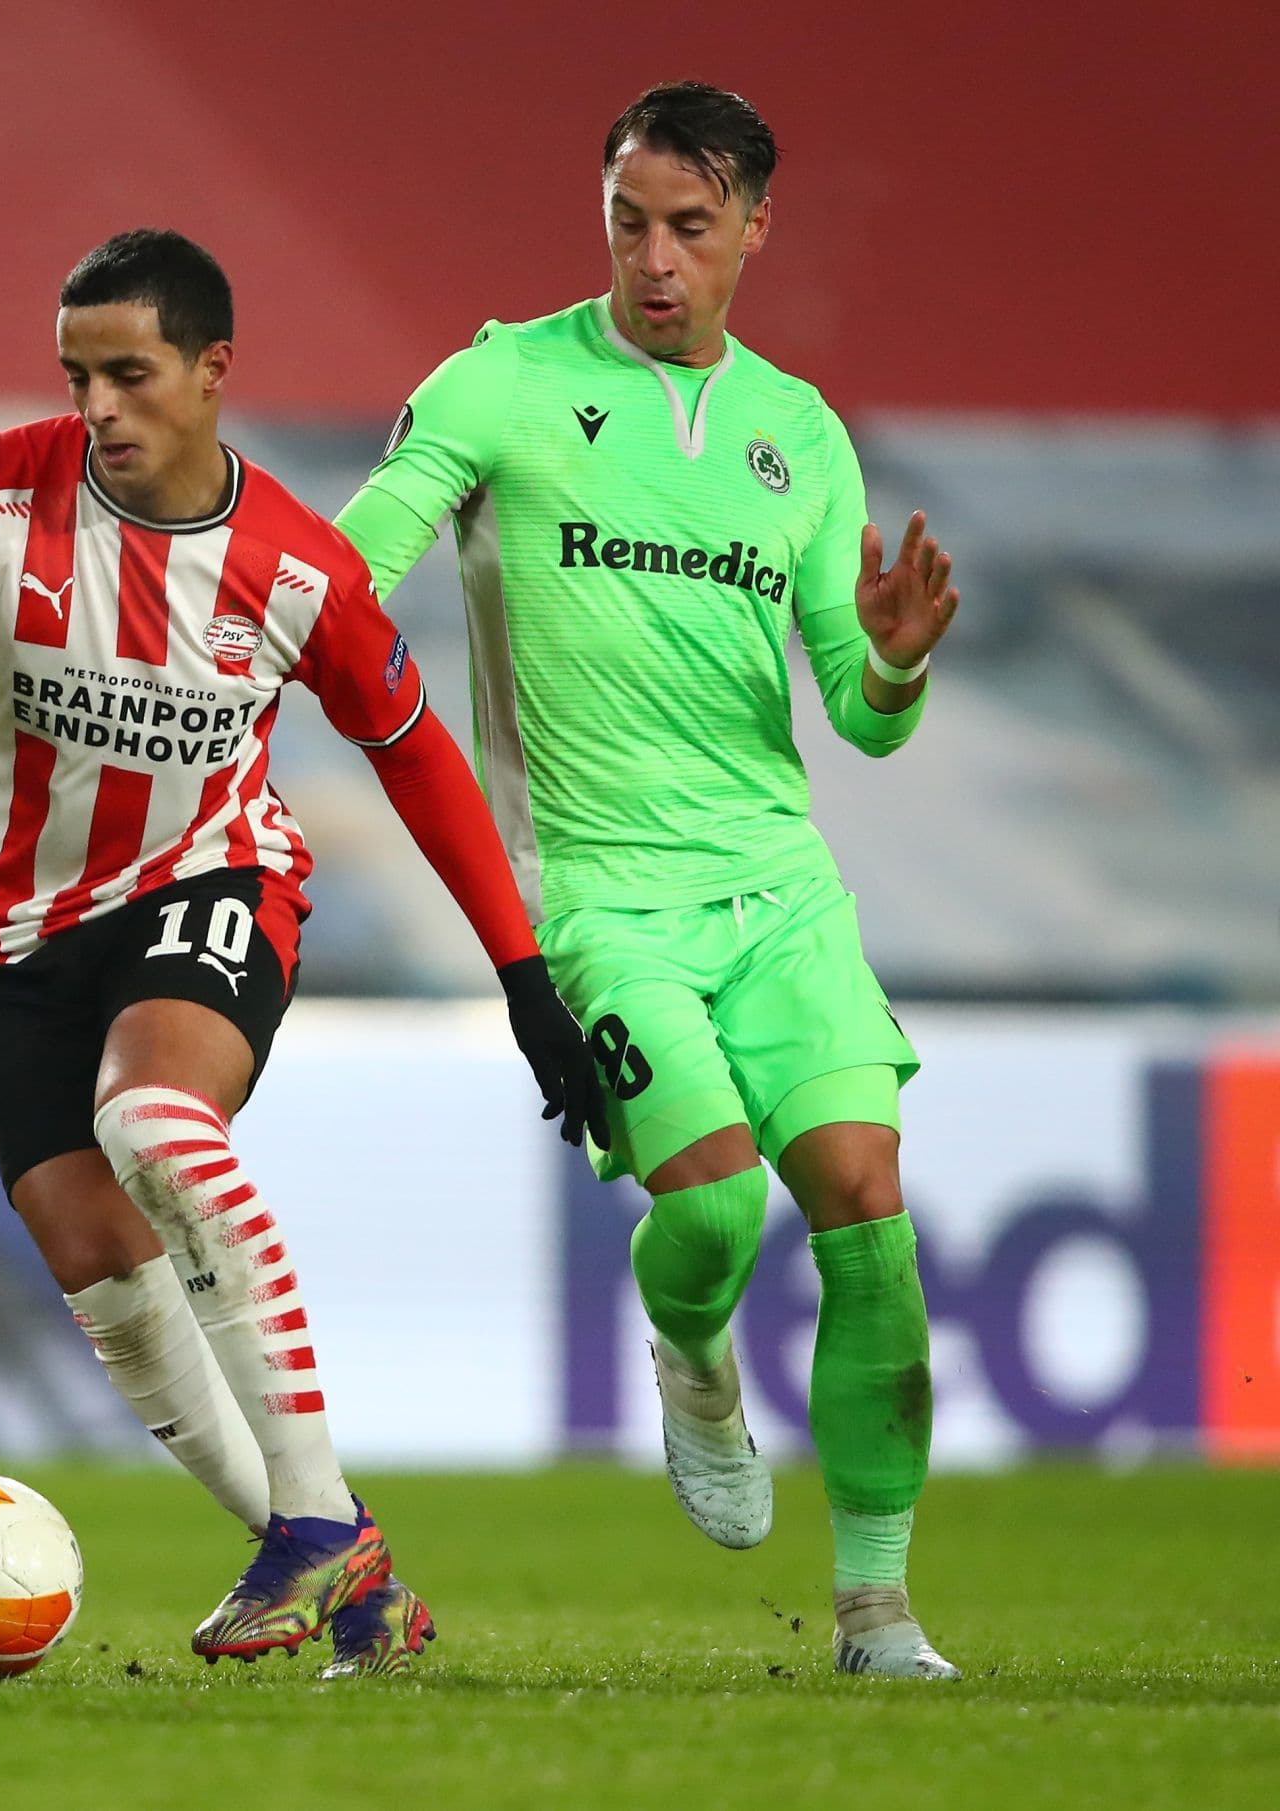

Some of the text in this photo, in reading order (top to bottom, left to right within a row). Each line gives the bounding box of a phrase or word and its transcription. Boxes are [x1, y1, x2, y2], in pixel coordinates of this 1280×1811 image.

[559, 522, 788, 605] Remedica
[222, 630, 245, 642] PSV
[13, 671, 257, 733] BRAINPORT
[64, 667, 217, 702] METROPOOLREGIO
[145, 897, 254, 963] 10
[591, 1013, 654, 1101] 8
[186, 1271, 217, 1294] PSV
